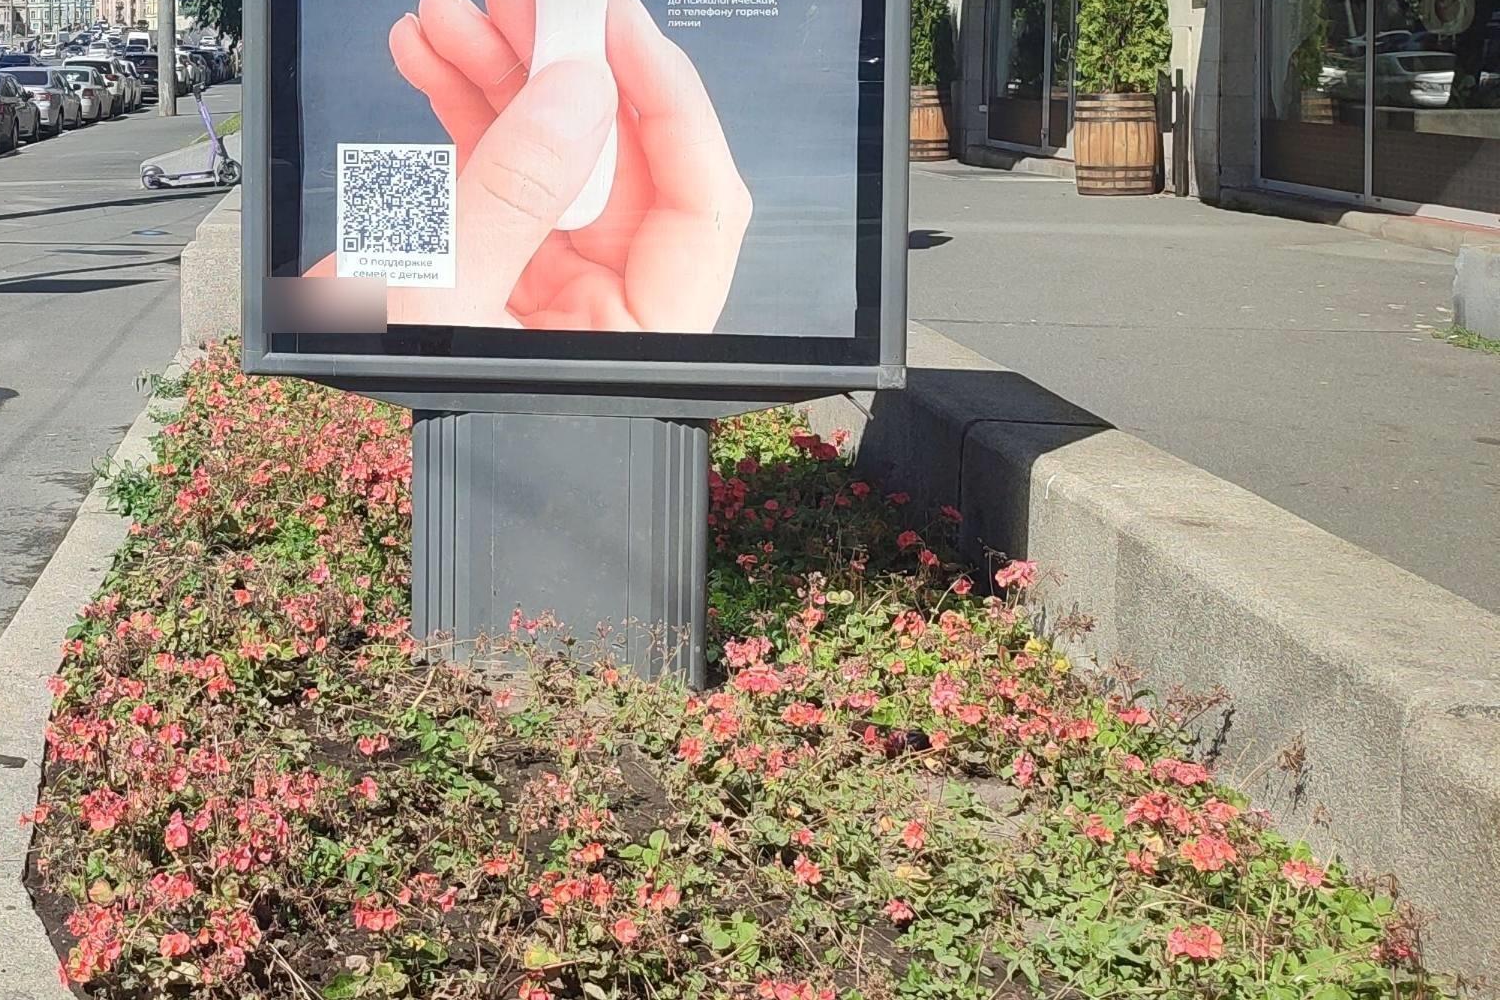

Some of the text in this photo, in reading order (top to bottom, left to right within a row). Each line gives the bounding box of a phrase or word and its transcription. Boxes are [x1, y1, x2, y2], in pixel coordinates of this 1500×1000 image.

[667, 7, 779, 18] по телефону горячей
[667, 20, 701, 28] линии
[359, 257, 433, 268] О поддержке
[353, 269, 387, 278] семей
[398, 271, 439, 280] детьми
